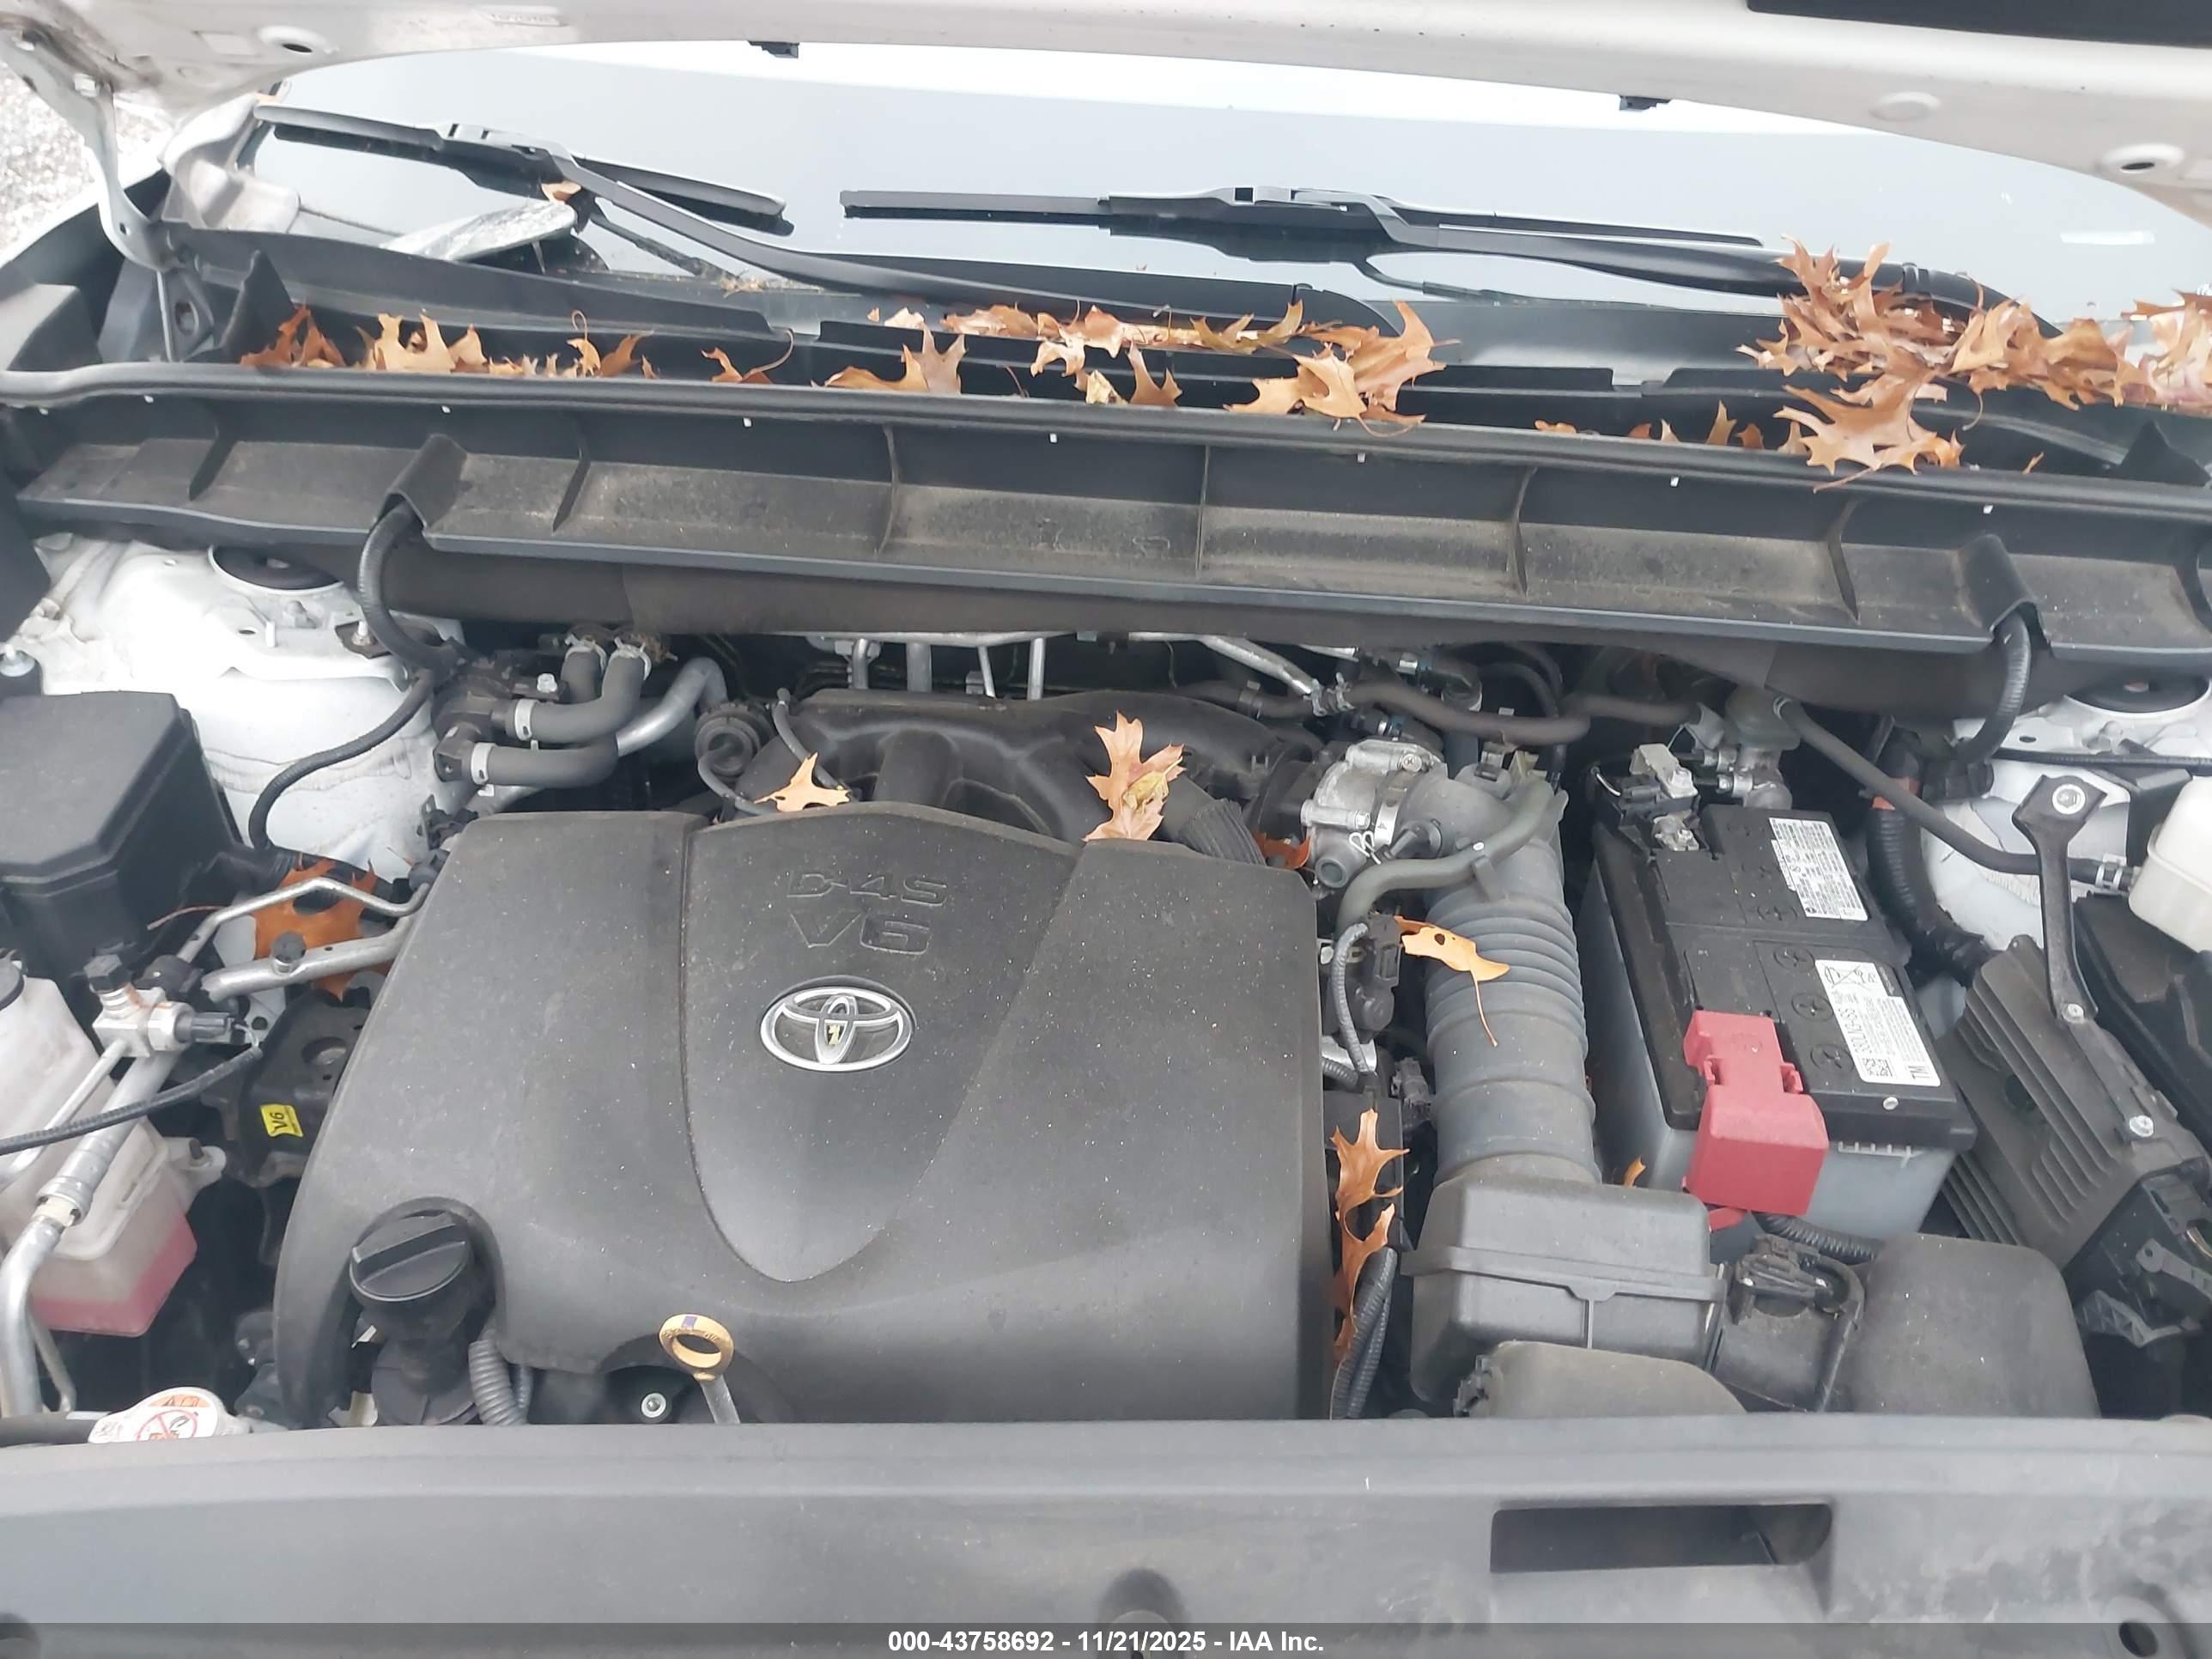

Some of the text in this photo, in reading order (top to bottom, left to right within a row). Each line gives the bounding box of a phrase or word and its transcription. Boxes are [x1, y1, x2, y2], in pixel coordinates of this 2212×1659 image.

[786, 872, 947, 907] D-4S
[788, 908, 933, 955] V6
[269, 1112, 288, 1130] V6
